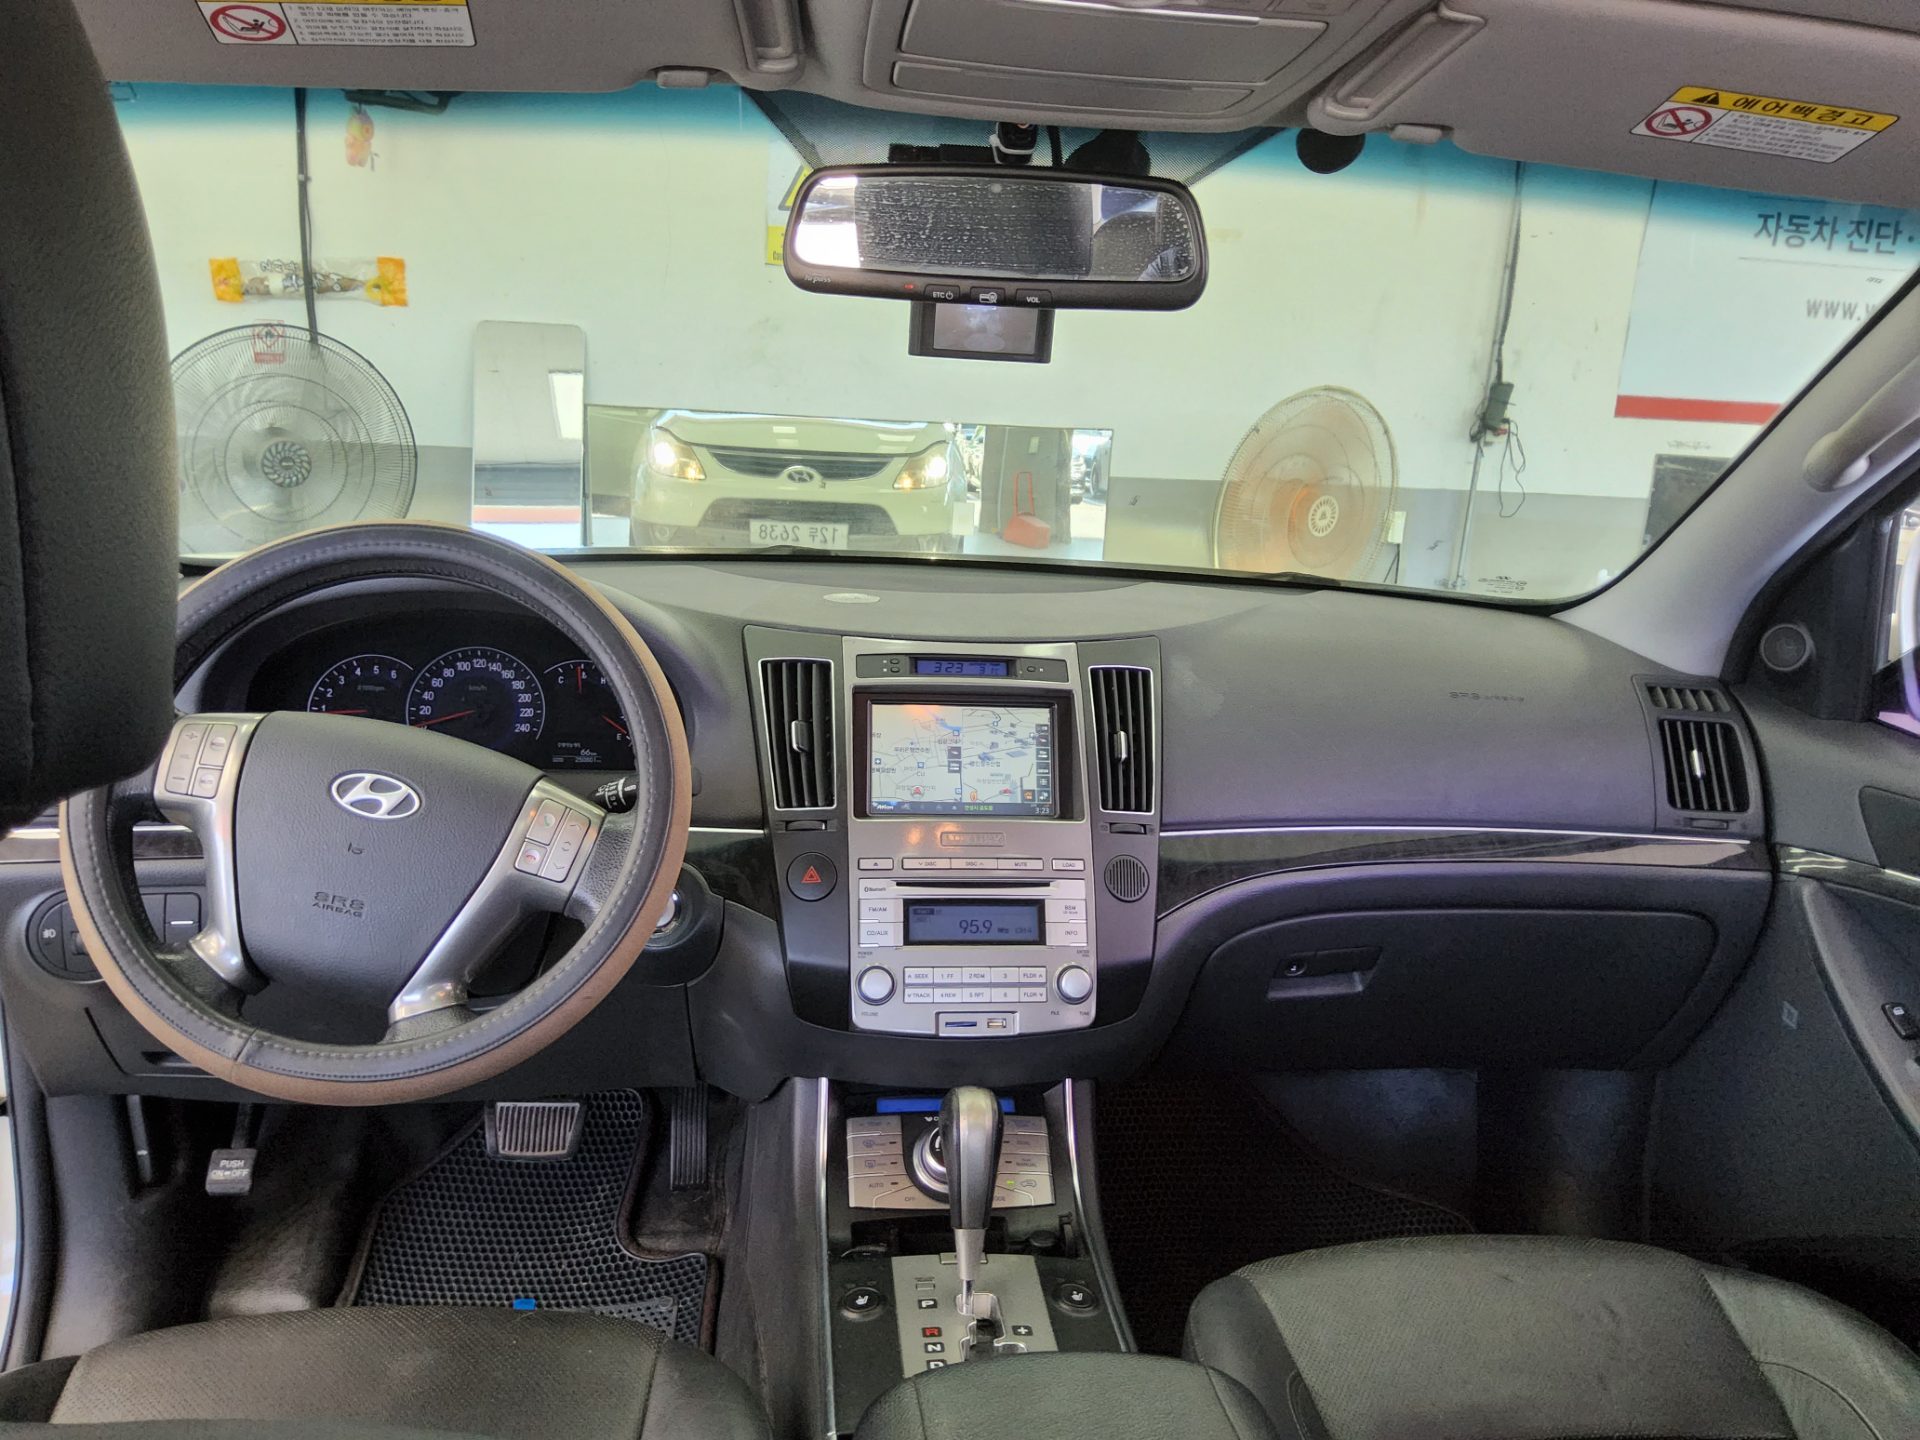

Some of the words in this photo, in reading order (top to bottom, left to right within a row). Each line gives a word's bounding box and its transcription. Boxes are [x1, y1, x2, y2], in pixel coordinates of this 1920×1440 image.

[1754, 211, 1838, 250] 자동차
[932, 291, 945, 299] ETC
[456, 661, 471, 671] 100
[472, 658, 487, 668] 120
[487, 662, 502, 671] 140
[354, 667, 361, 676] 4
[373, 665, 380, 674] 5
[390, 669, 397, 679] 6
[442, 668, 455, 677] 80
[501, 669, 515, 679] 160
[338, 675, 345, 685] 3
[431, 678, 444, 688] 60
[511, 680, 525, 690] 180
[326, 688, 333, 698] 2
[422, 691, 435, 701] 40
[518, 693, 532, 703] 200
[419, 705, 432, 715] 20
[520, 707, 534, 717] 220
[514, 723, 530, 732] 240
[959, 919, 993, 934] 95.9
[219, 1159, 245, 1168] PUSH
[921, 1300, 935, 1308] P
[927, 1343, 942, 1352] N
